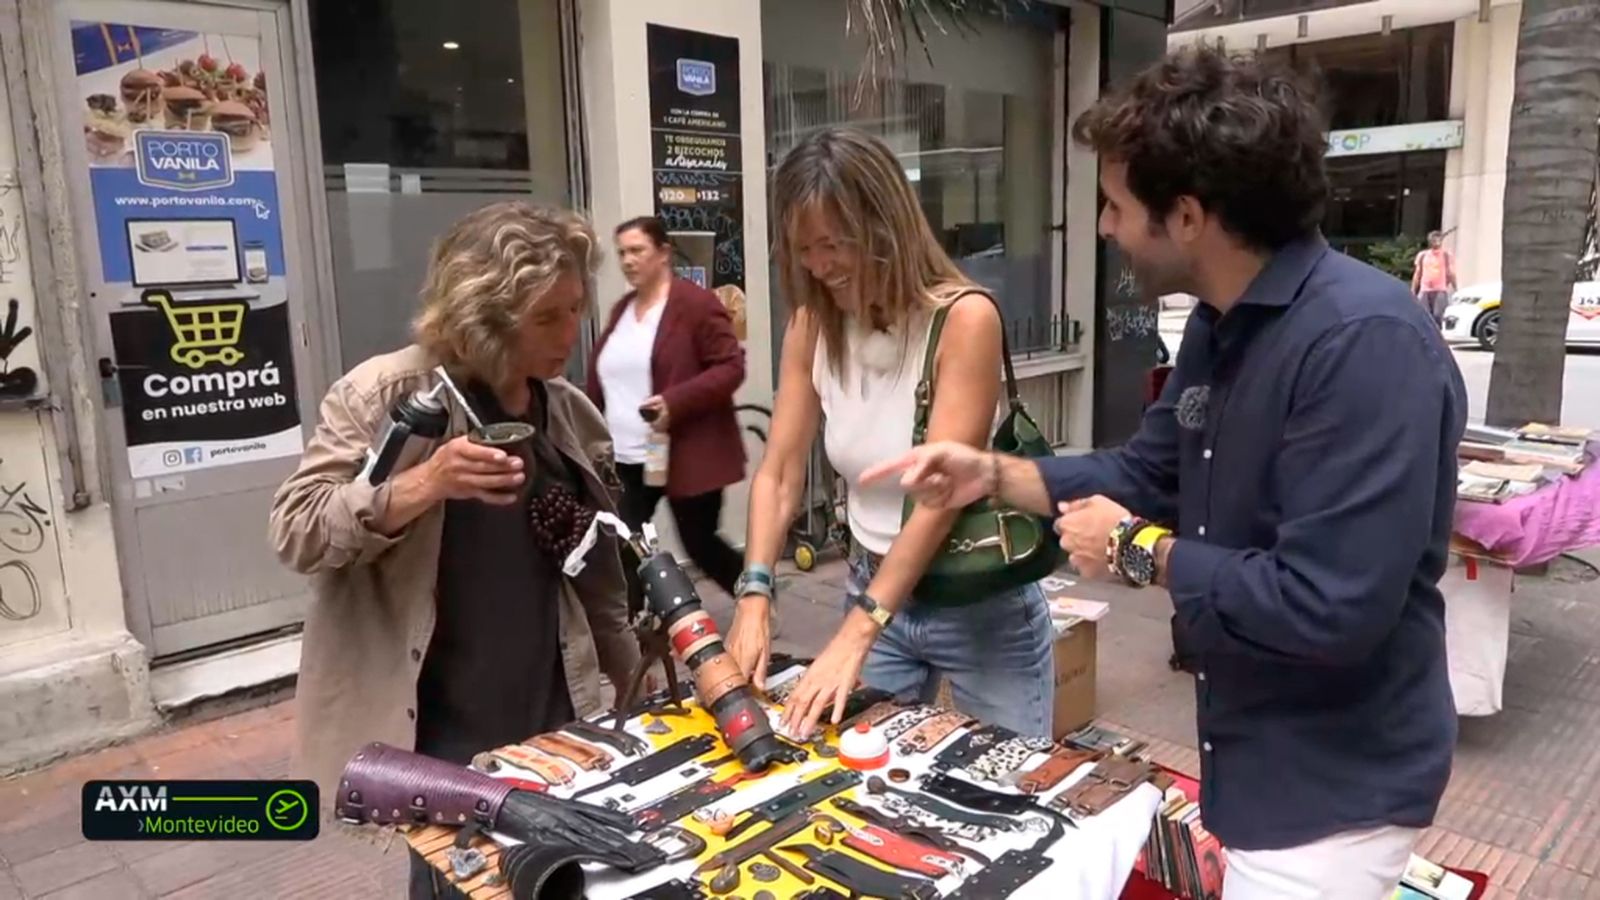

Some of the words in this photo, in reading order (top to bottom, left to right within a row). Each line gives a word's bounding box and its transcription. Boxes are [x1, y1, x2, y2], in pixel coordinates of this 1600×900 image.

[147, 140, 219, 158] PORTO
[150, 157, 220, 171] VANILA
[143, 360, 281, 397] Comprá
[141, 407, 167, 421] en
[171, 398, 246, 418] nuestra
[248, 392, 286, 409] web
